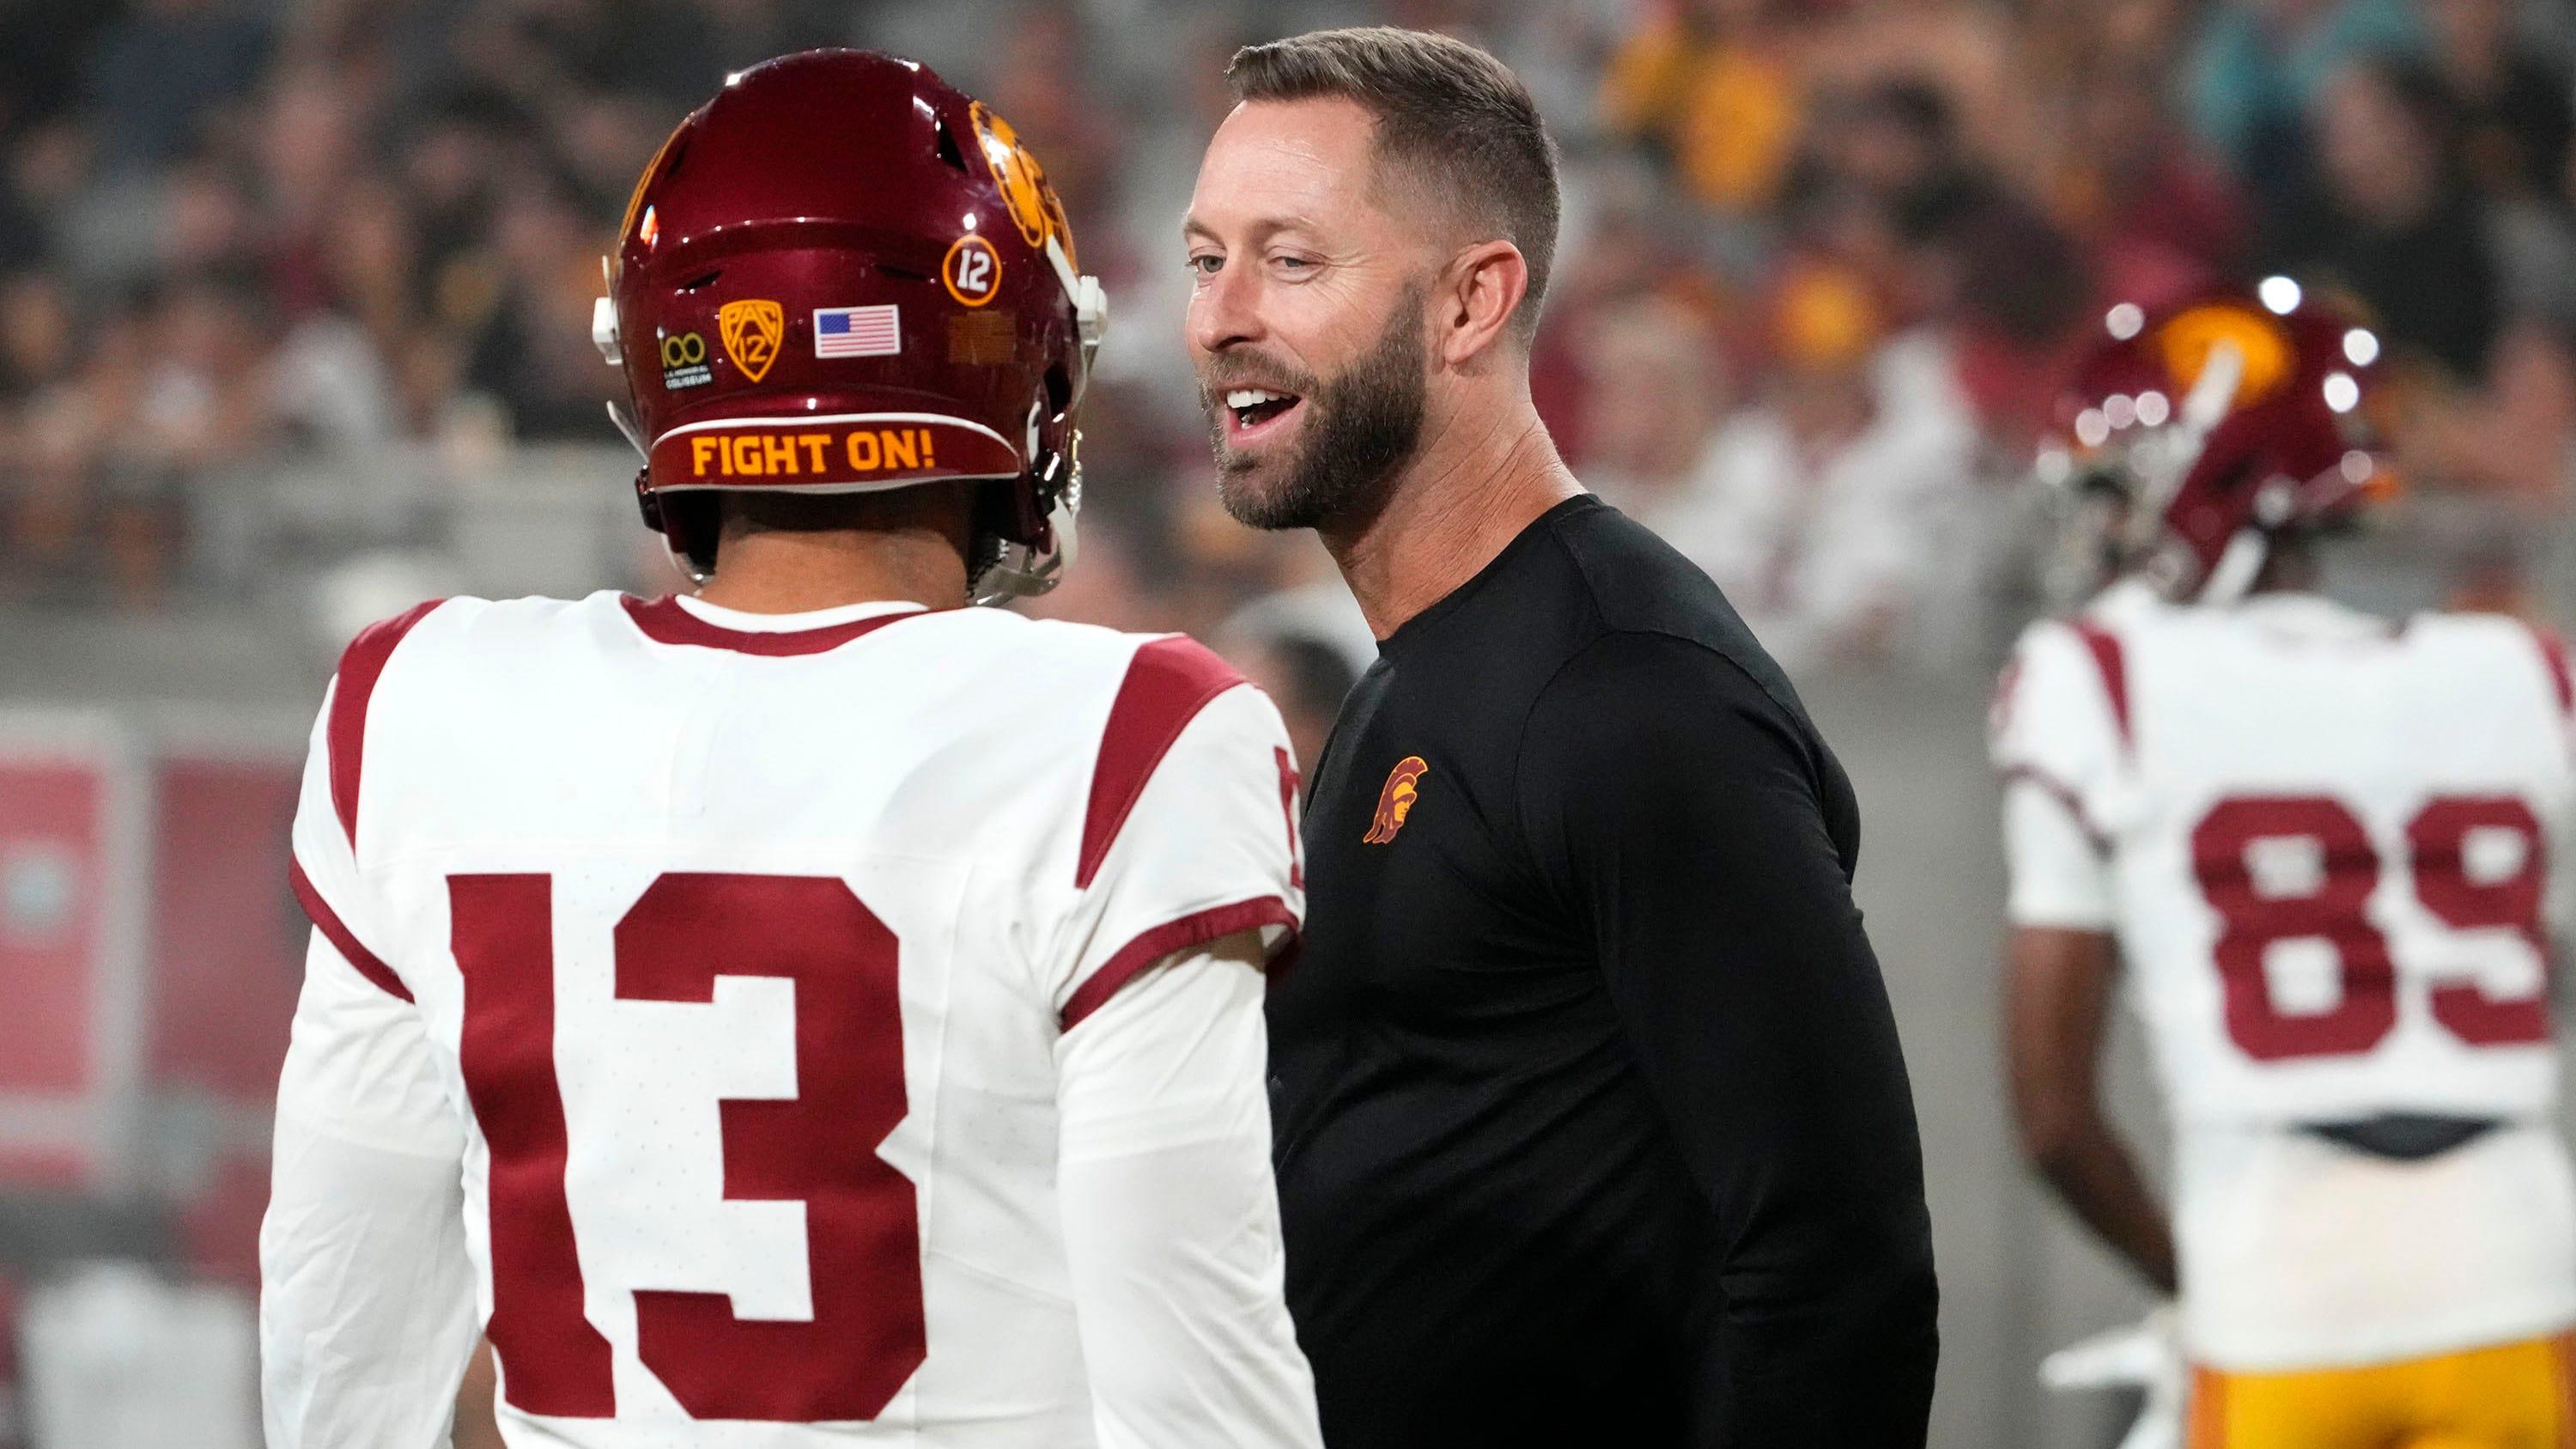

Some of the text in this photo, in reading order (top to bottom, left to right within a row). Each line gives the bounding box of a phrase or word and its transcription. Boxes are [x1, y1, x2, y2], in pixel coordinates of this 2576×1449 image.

[957, 249, 991, 293] 12
[739, 336, 767, 362] 12
[691, 429, 935, 476] FIGHT ON!
[2190, 794, 2550, 1059] 89
[446, 872, 927, 1422] 13
